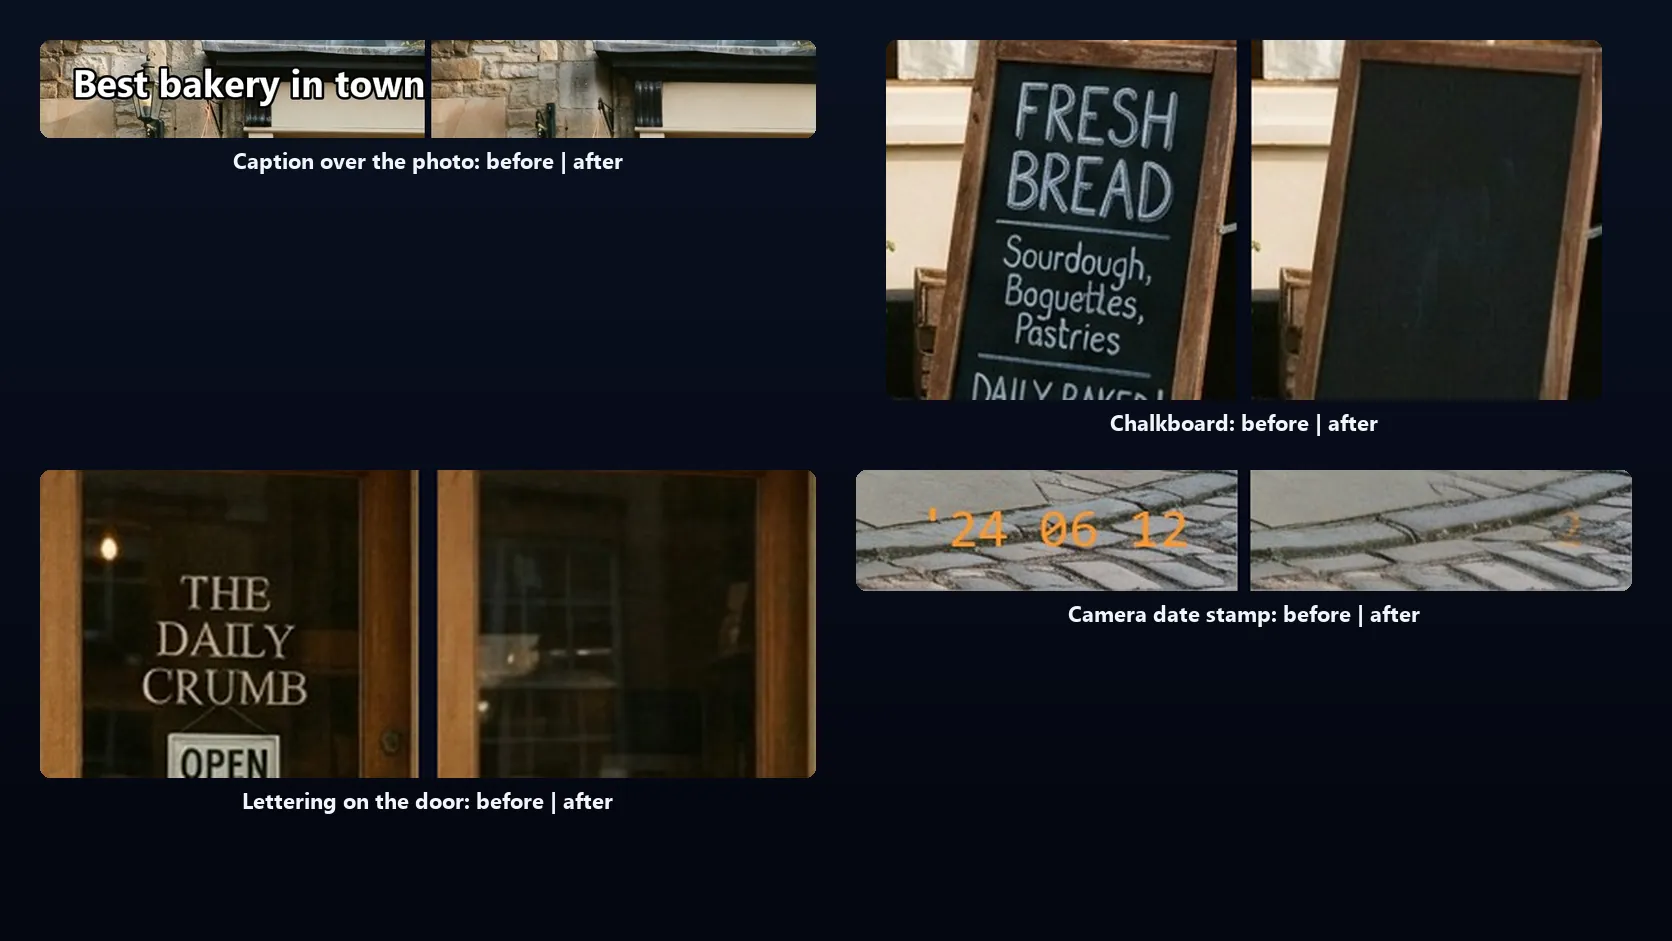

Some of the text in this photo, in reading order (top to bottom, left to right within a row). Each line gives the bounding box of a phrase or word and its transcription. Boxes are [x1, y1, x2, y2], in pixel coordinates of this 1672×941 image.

[1015, 82, 1178, 151] FRESH
[1007, 150, 1174, 222] BREAD
[1003, 234, 1152, 292] Sourdough,
[1014, 312, 1121, 356] Pastries
[180, 575, 272, 612] THE
[156, 620, 296, 660] DAILY
[142, 667, 308, 706] CRUMB
[181, 747, 268, 778] OPEN
